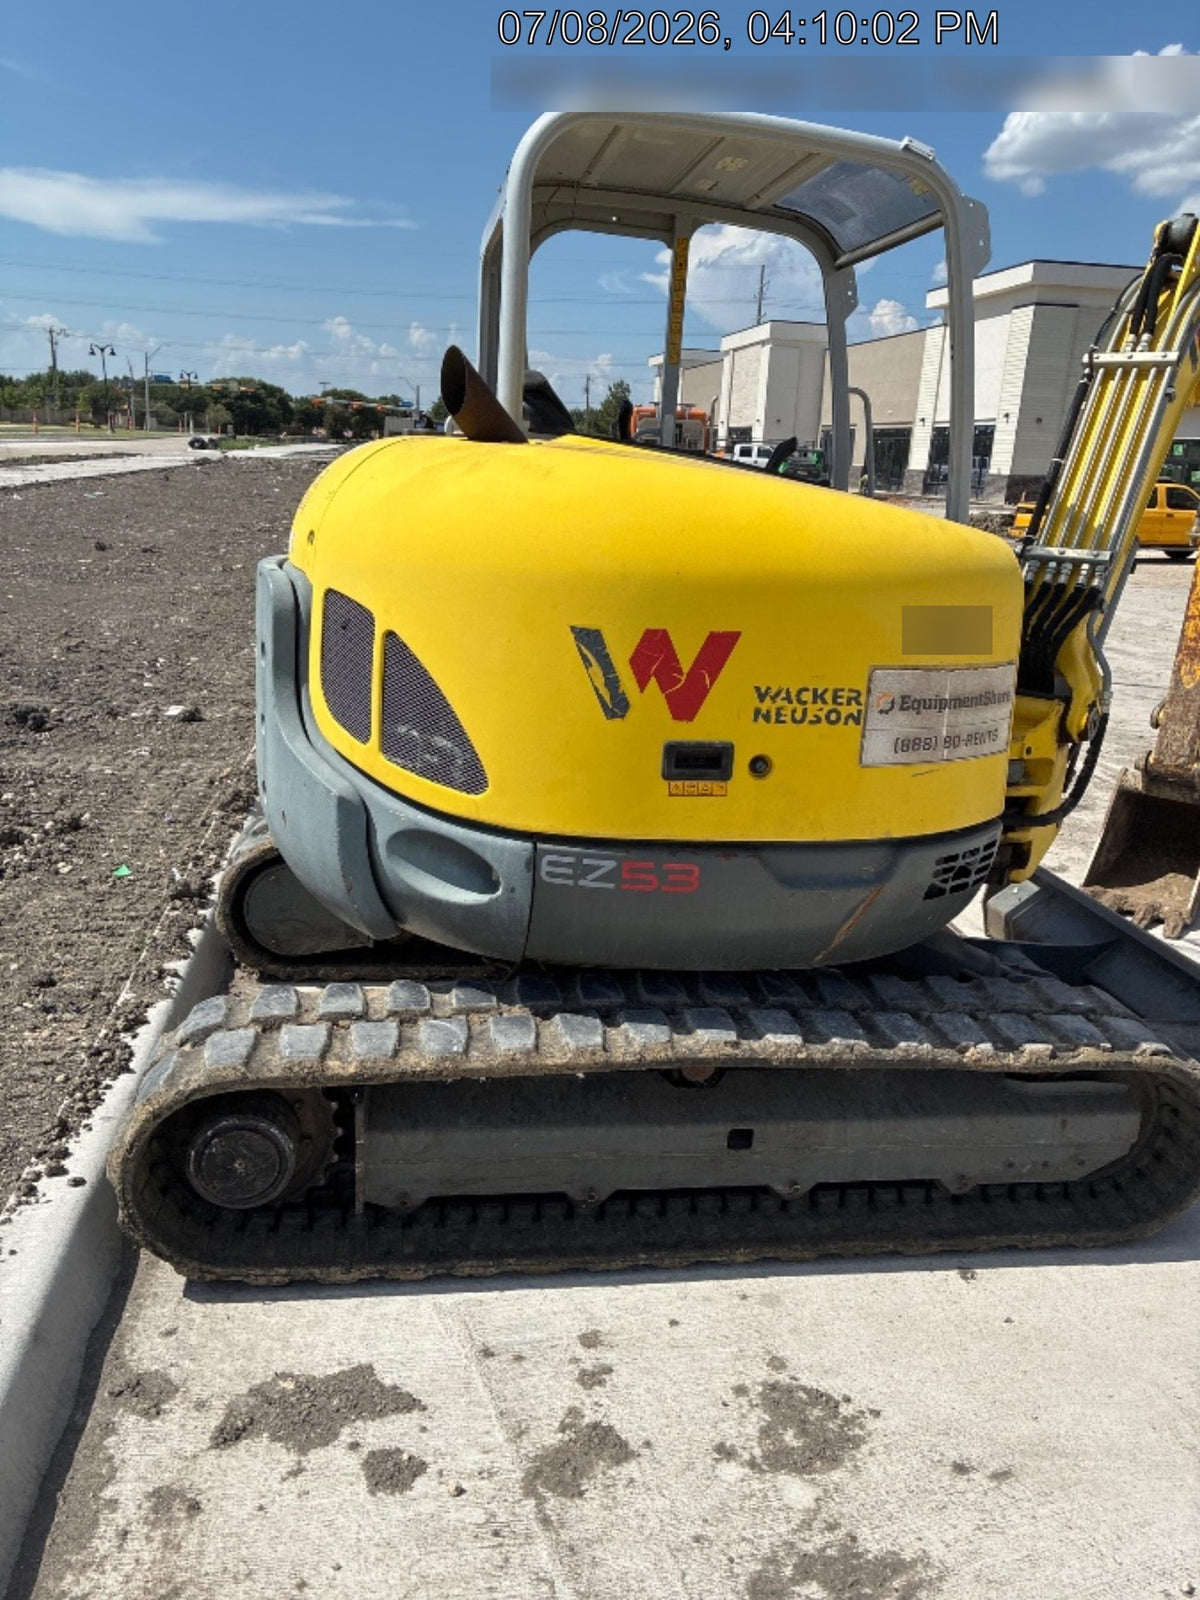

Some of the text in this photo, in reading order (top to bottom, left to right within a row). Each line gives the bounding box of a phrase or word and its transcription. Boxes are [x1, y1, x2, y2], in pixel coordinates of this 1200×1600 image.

[753, 685, 863, 706] WACKER
[753, 706, 863, 726] NEUSON
[893, 736, 938, 754] (888)
[540, 855, 700, 893] EZ53
